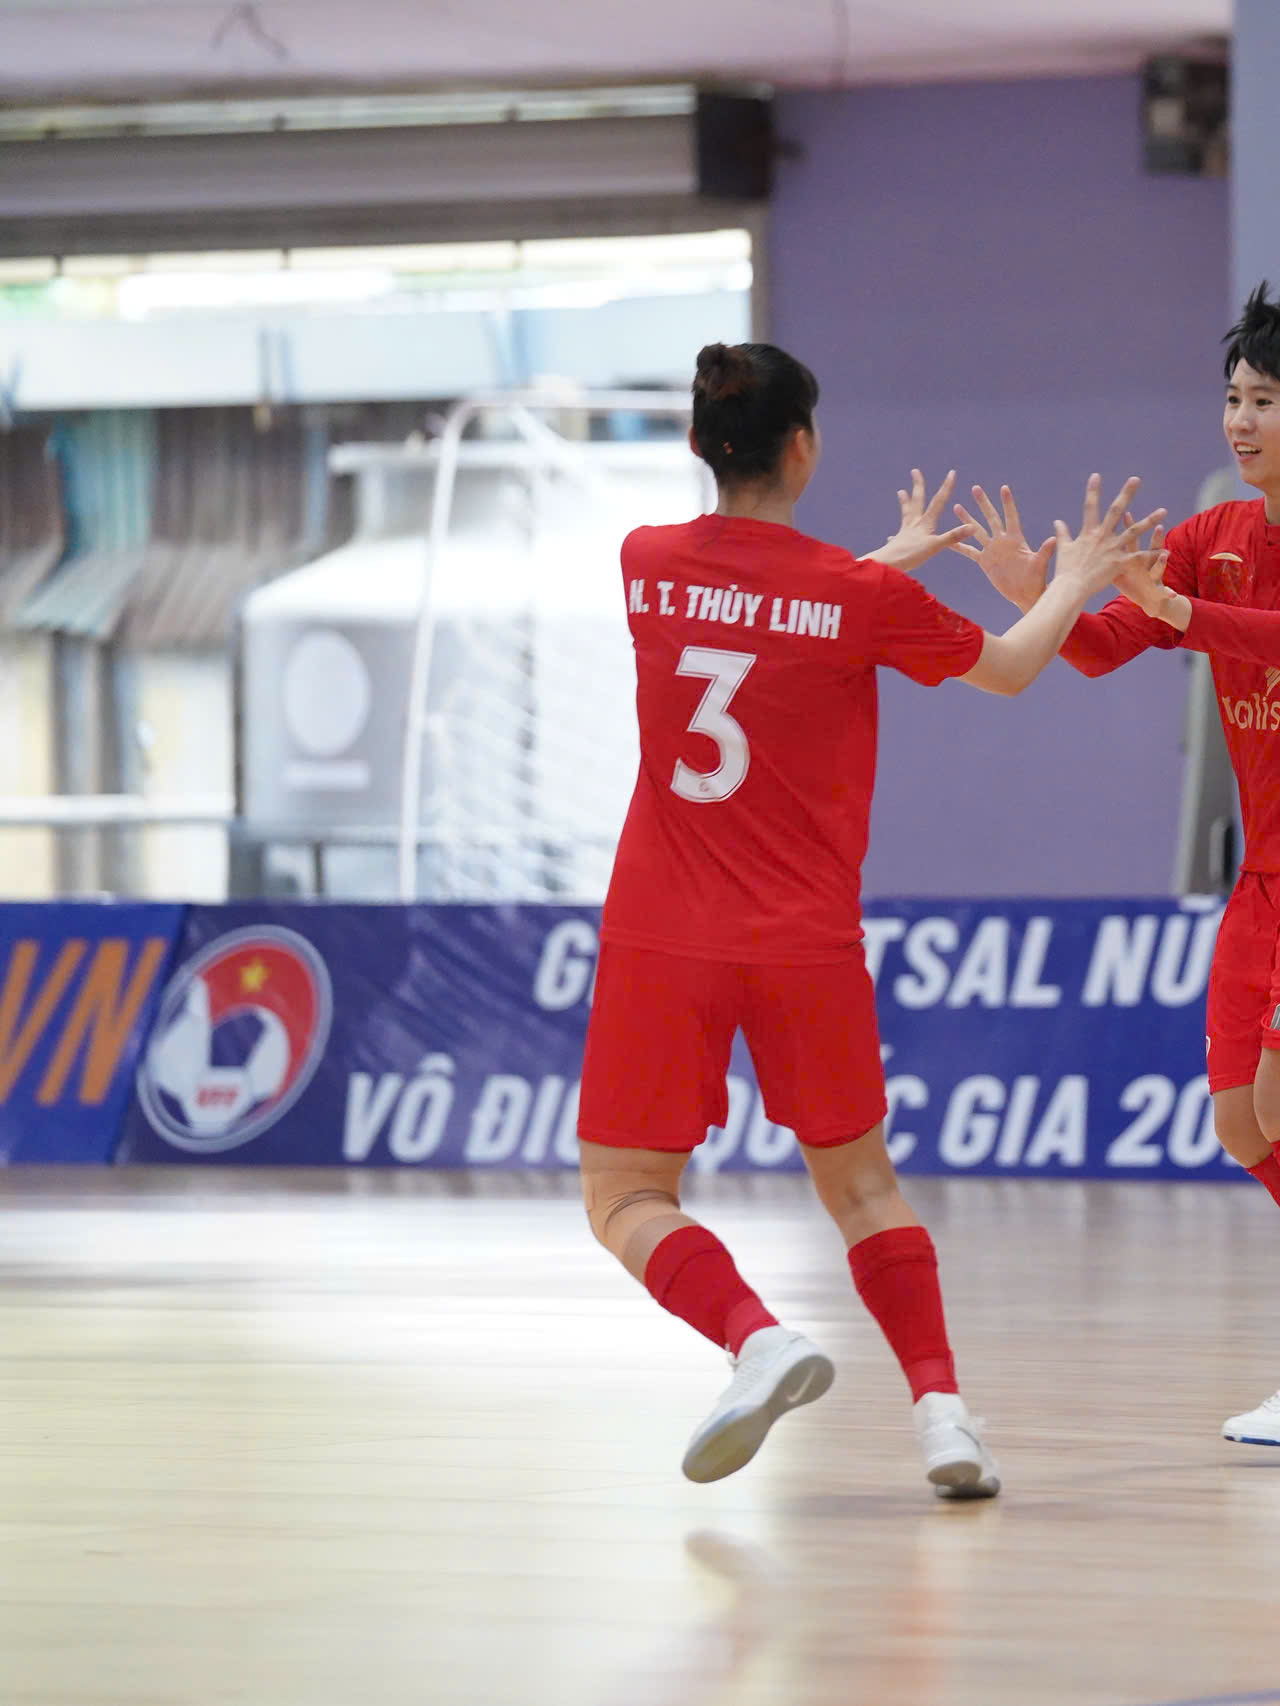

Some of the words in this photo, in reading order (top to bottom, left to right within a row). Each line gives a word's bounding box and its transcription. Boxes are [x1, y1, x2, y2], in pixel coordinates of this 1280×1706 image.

[656, 581, 675, 616] T.
[769, 597, 842, 639] LINH
[670, 645, 757, 803] 3
[342, 1051, 456, 1164] VÔ
[938, 1075, 1088, 1168] GIA
[1104, 1072, 1242, 1170] 20
